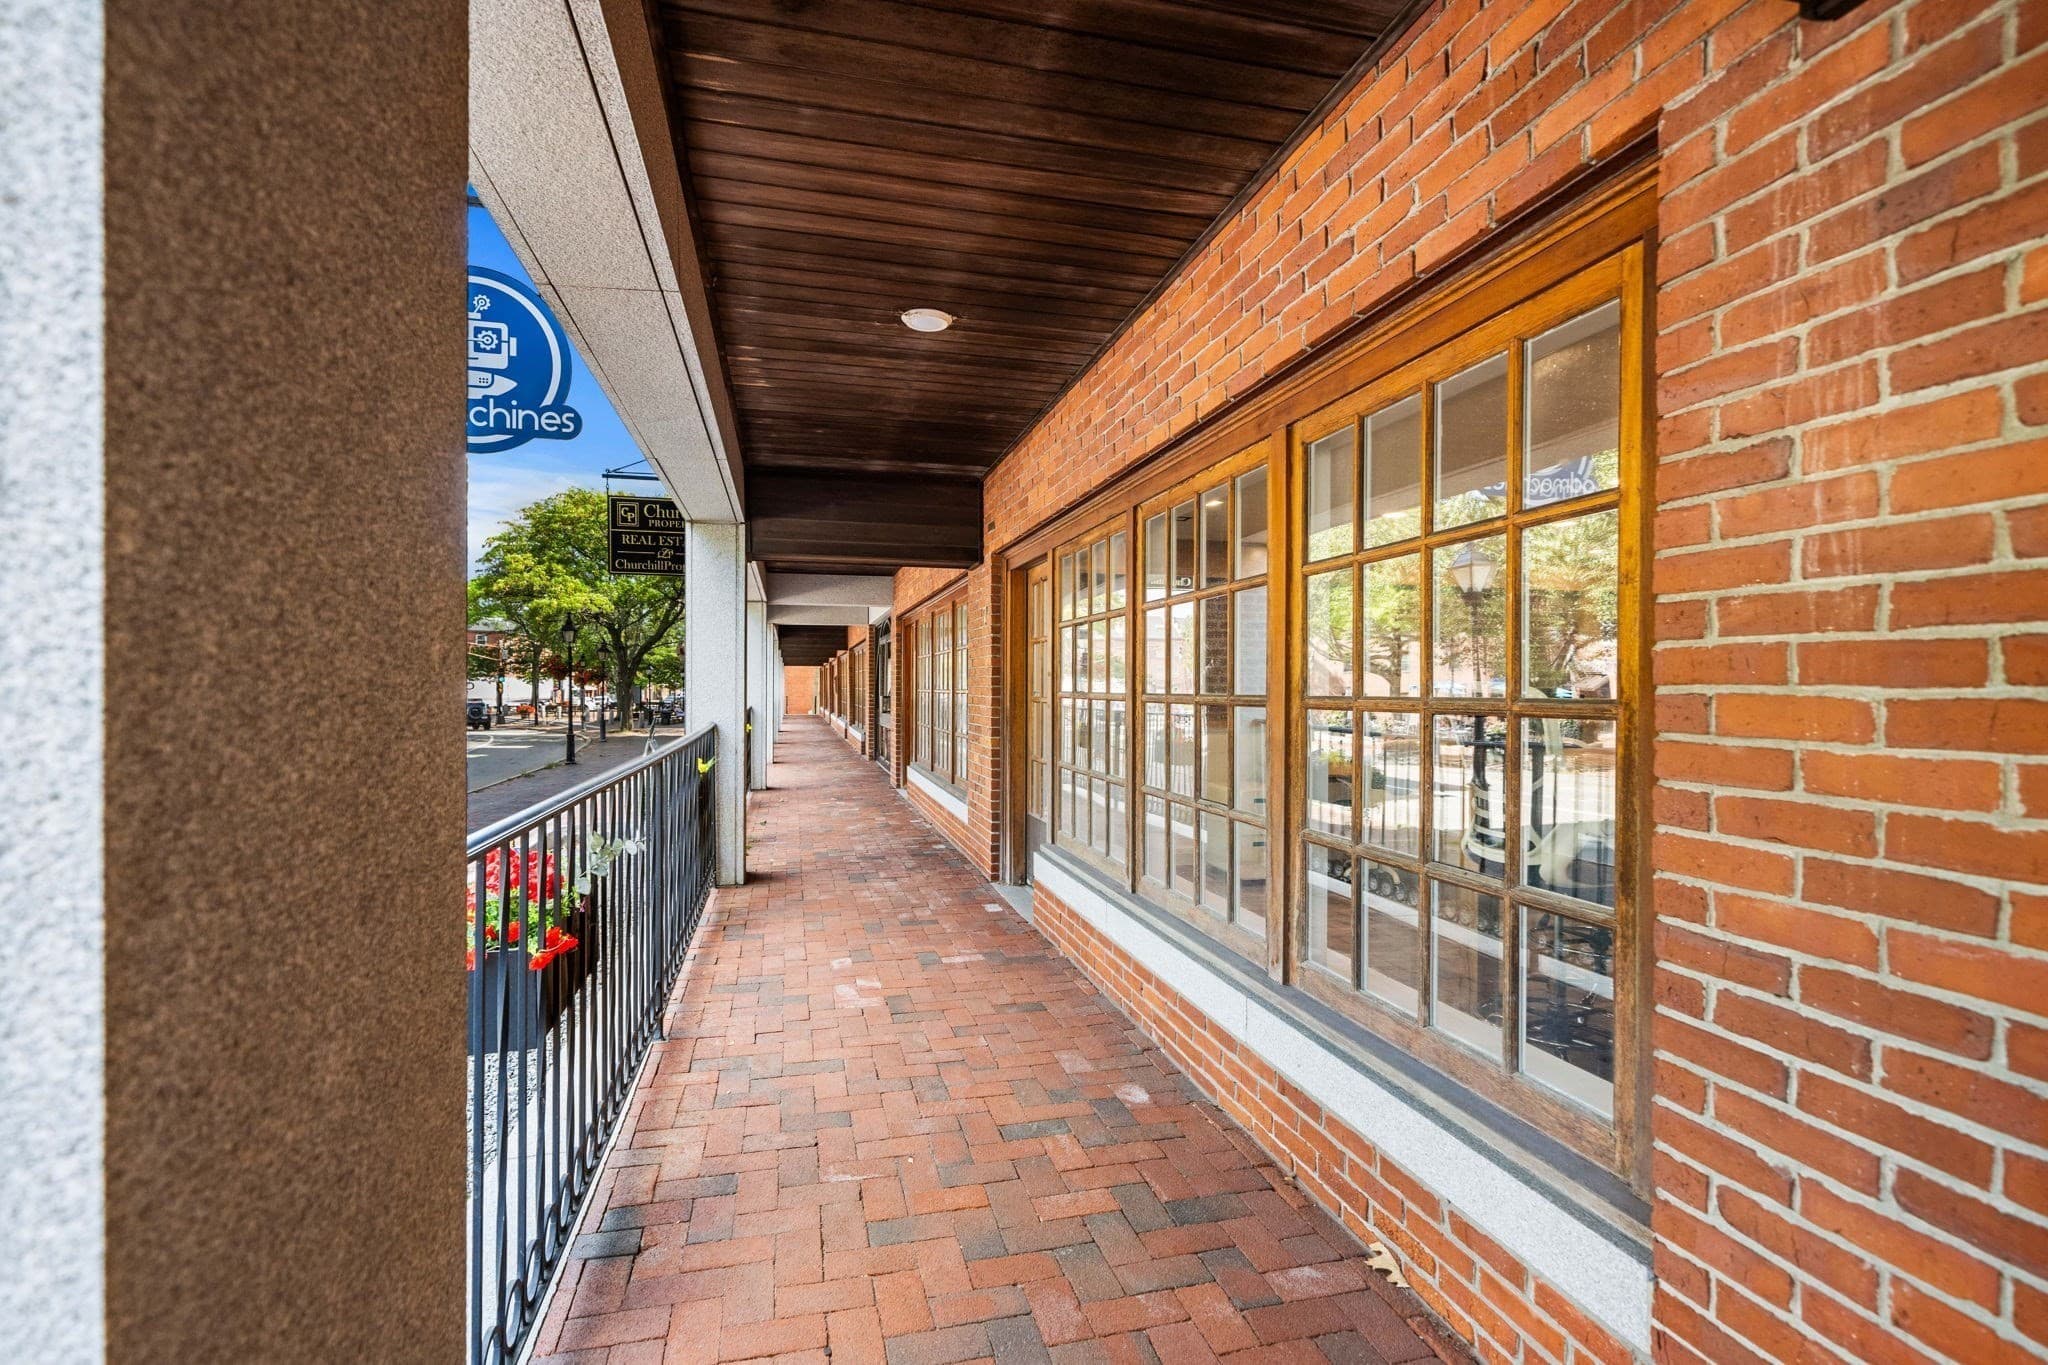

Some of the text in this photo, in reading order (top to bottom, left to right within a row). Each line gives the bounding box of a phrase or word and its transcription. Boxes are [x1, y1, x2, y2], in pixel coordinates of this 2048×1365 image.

[466, 398, 575, 433] chines
[622, 534, 685, 547] REAL EST
